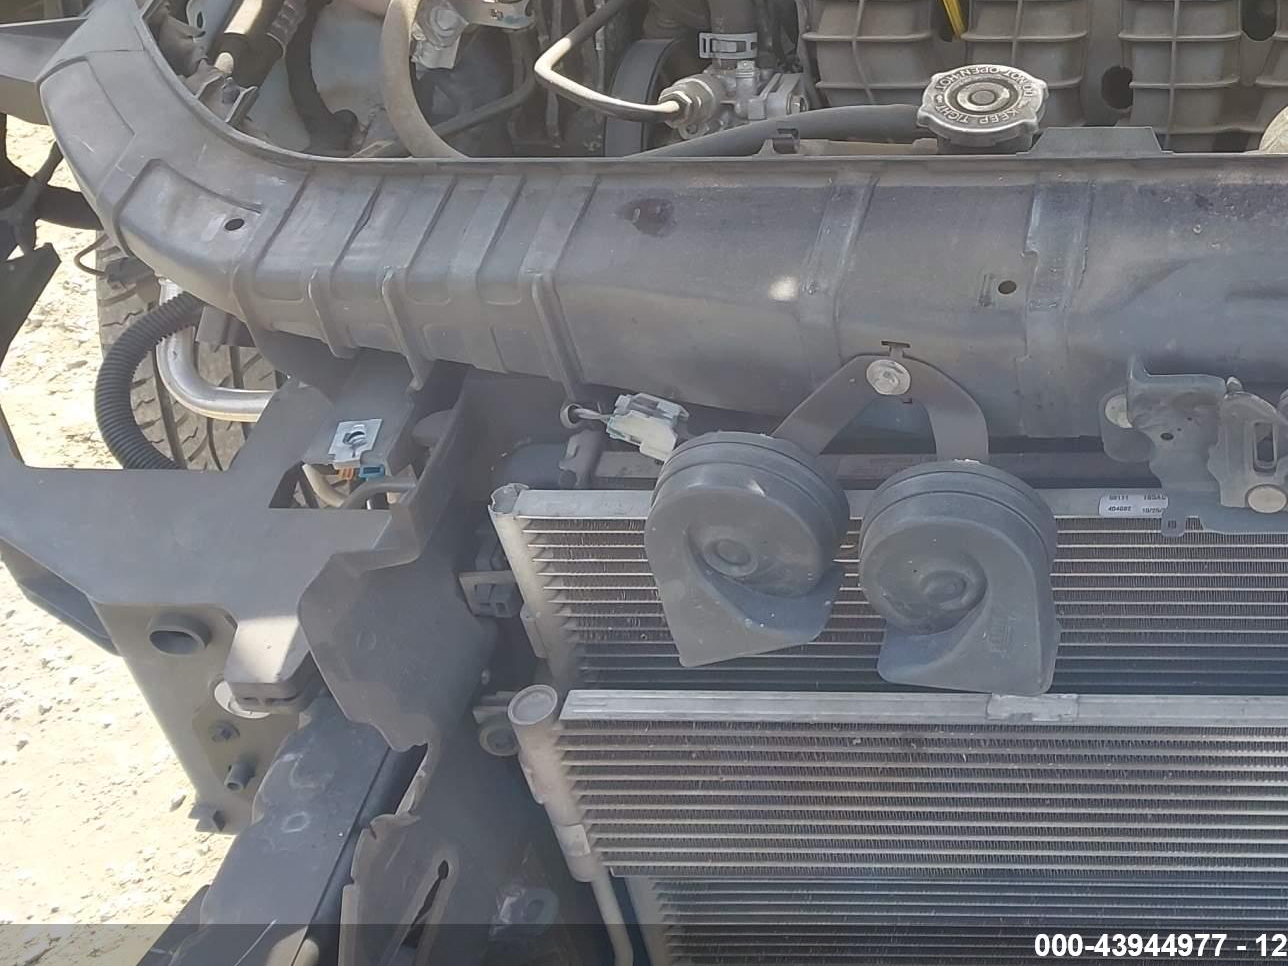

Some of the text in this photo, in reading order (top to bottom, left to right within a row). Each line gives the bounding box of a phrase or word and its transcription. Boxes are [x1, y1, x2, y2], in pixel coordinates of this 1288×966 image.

[935, 72, 960, 90] HOT
[959, 67, 998, 77] OPEN
[935, 105, 1020, 124] KEEP TIGHT
